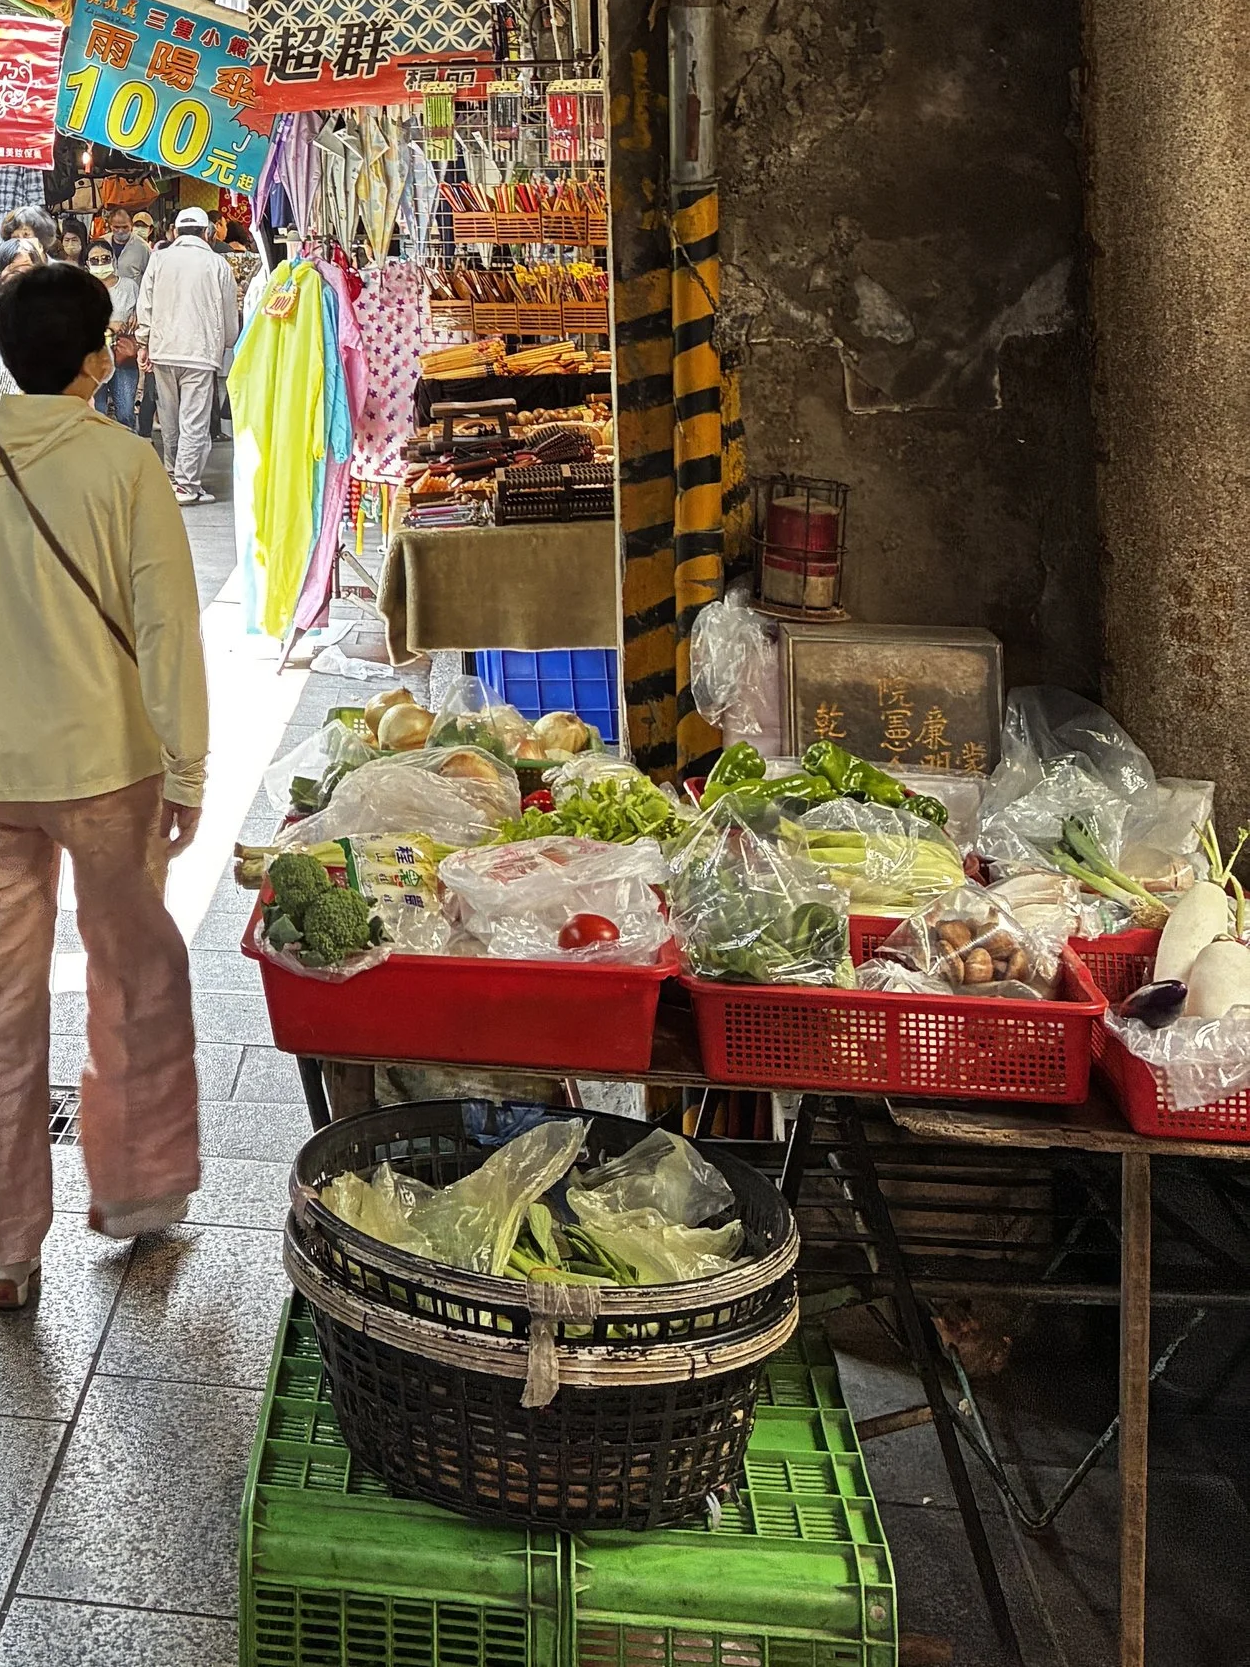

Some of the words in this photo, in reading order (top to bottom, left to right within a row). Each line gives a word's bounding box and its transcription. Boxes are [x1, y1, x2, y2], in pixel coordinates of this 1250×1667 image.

[84, 20, 257, 109] 雨陽傘
[144, 8, 250, 59] 三隻小熊
[265, 17, 399, 85] 超群
